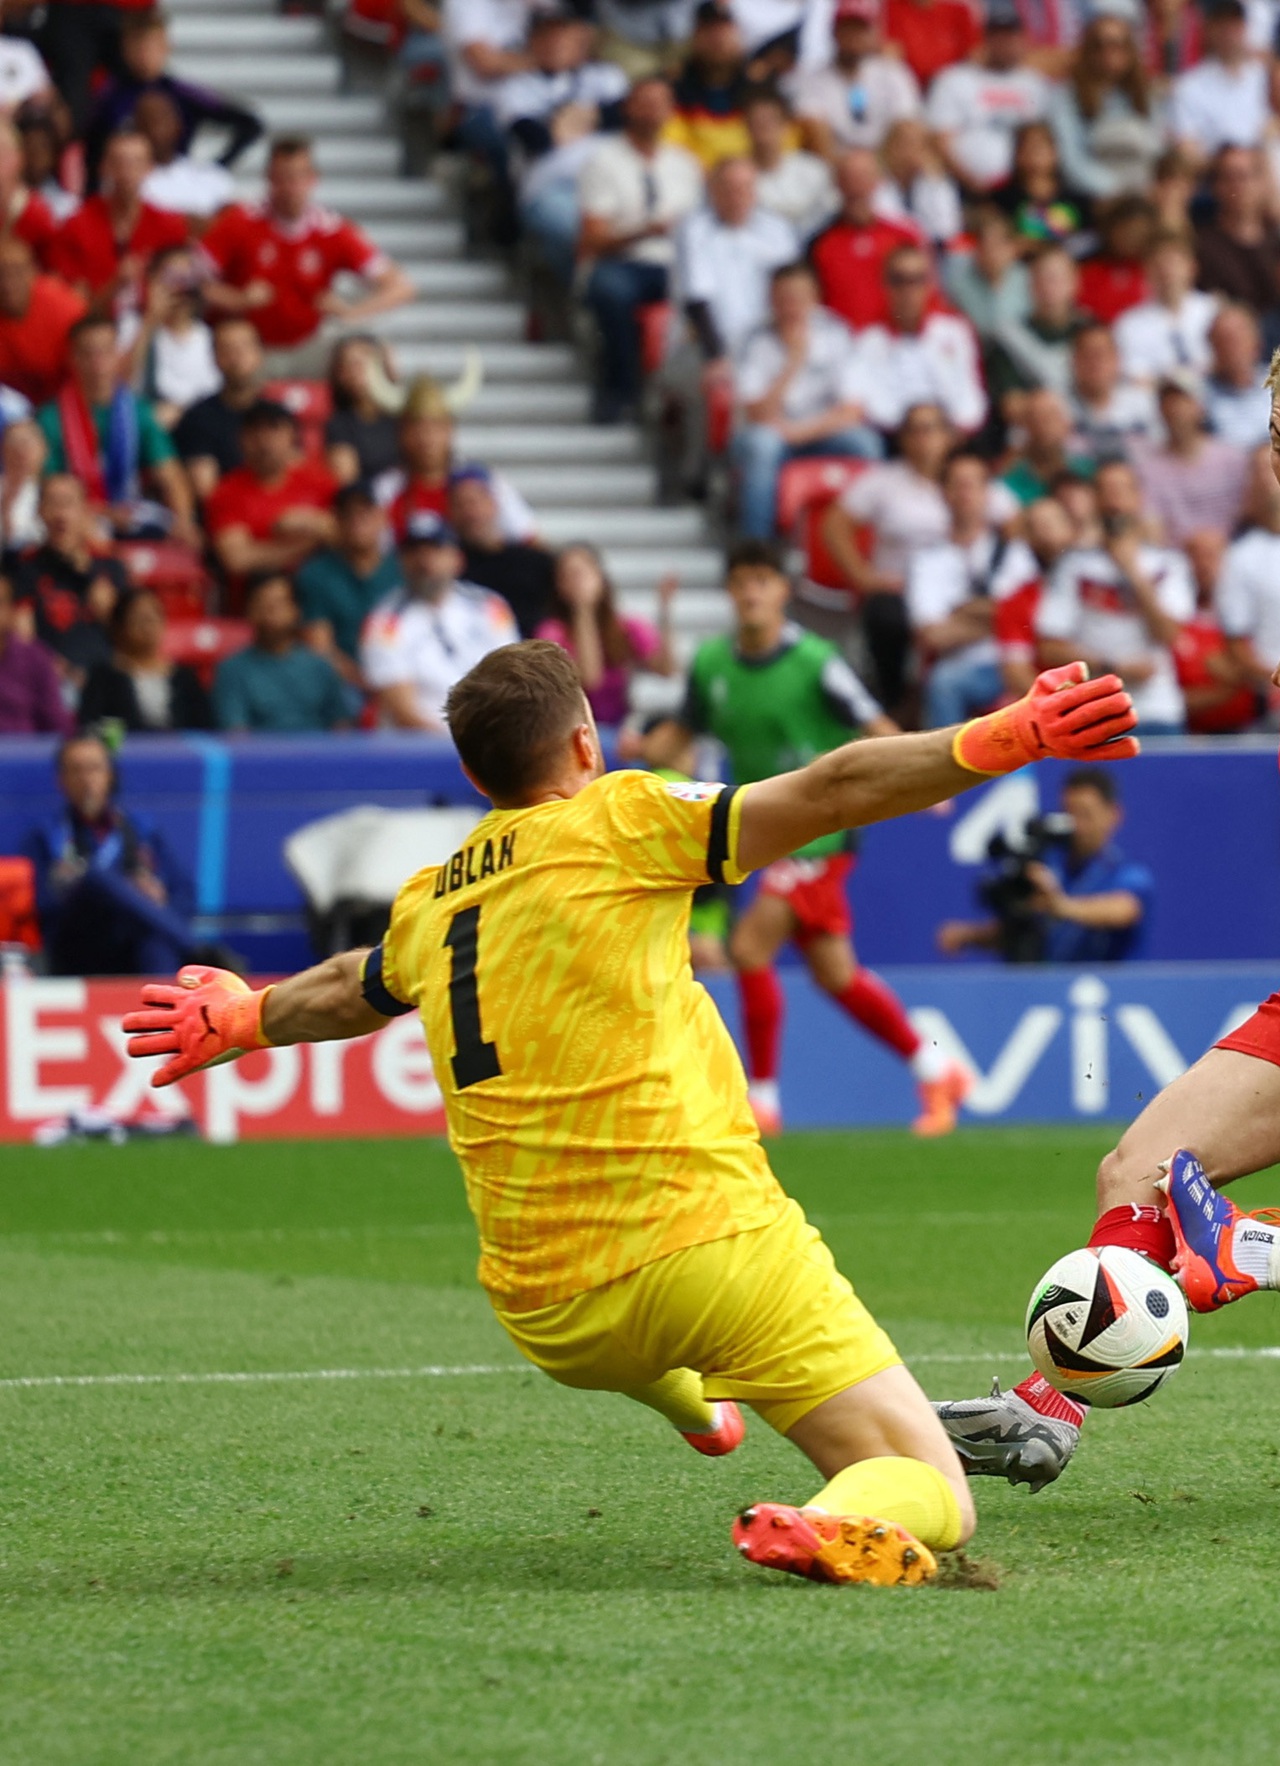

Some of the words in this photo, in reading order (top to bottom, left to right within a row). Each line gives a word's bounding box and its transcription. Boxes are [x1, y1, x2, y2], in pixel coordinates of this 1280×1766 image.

[5, 977, 447, 1144] Expre
[443, 904, 501, 1090] 1
[910, 973, 1262, 1116] viv
